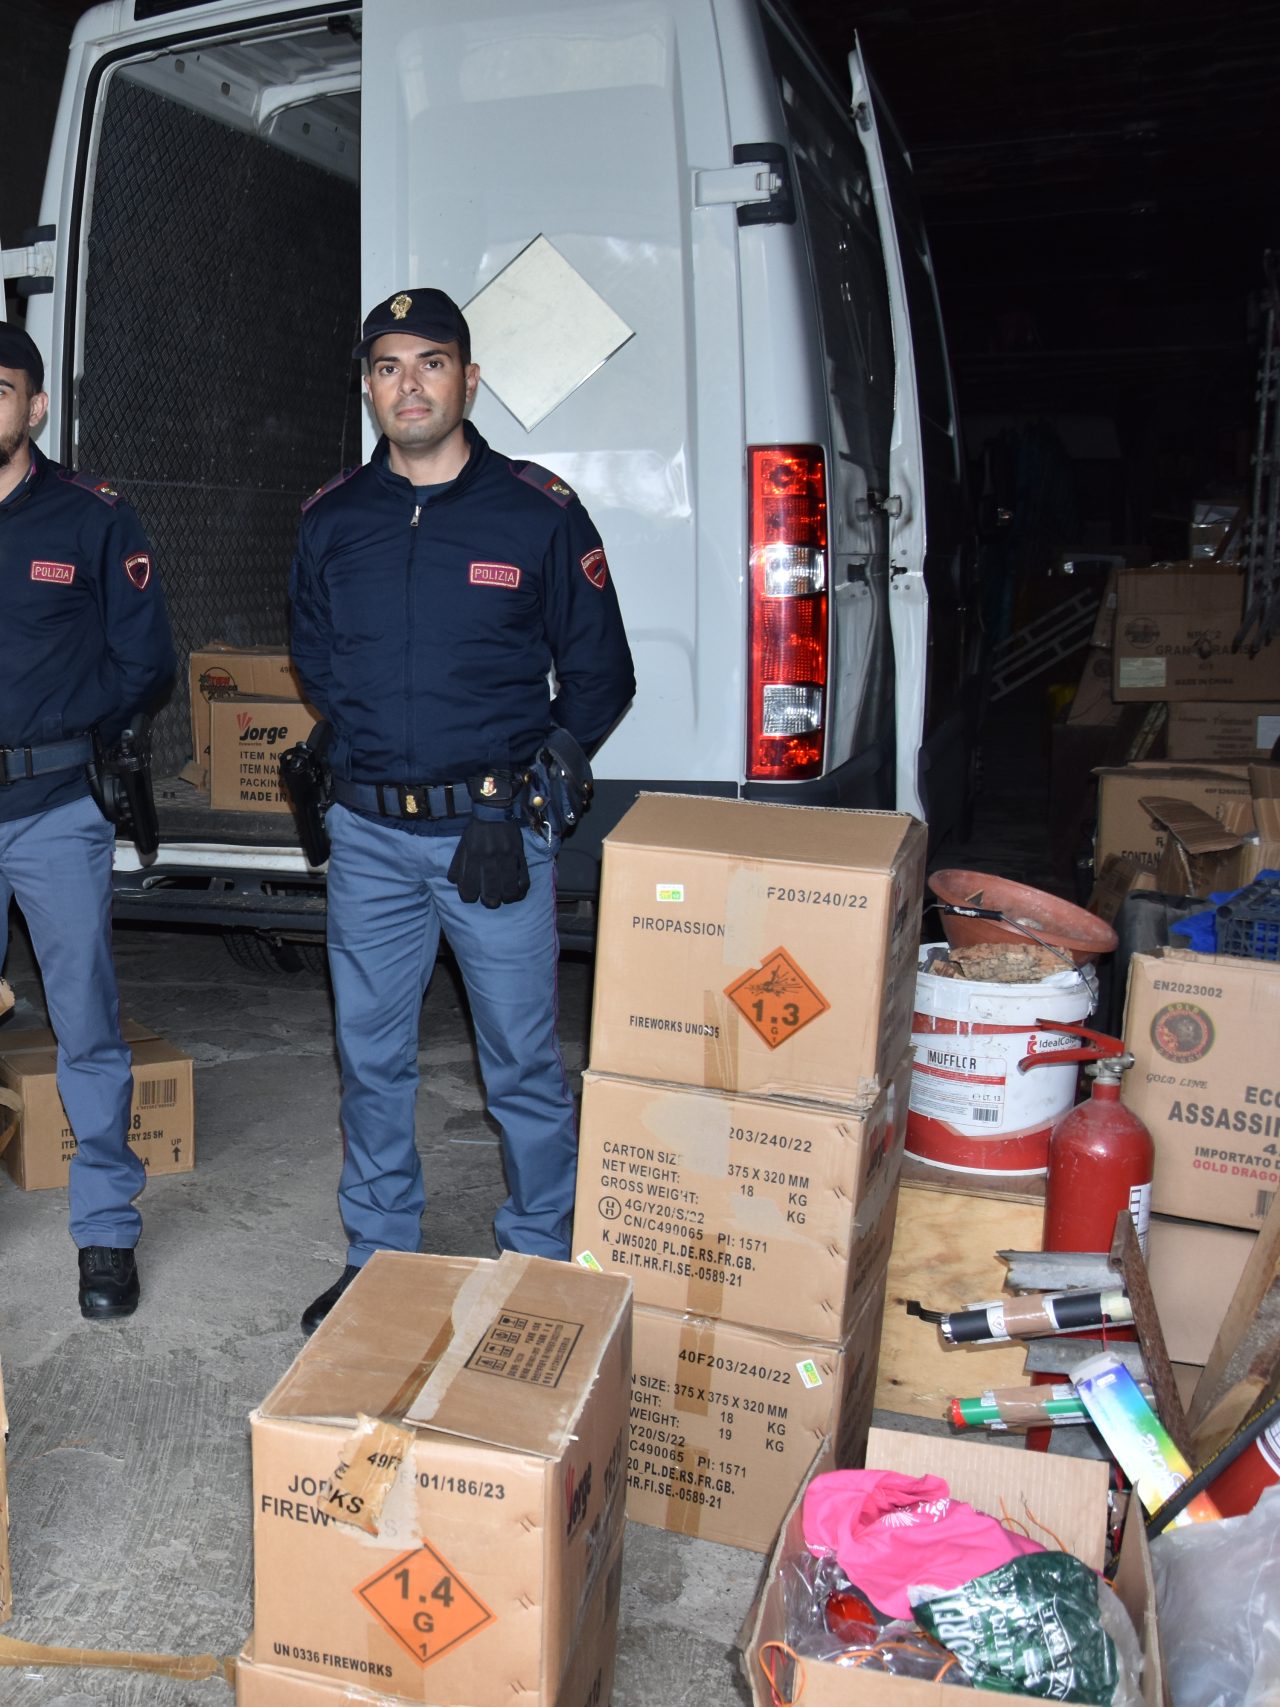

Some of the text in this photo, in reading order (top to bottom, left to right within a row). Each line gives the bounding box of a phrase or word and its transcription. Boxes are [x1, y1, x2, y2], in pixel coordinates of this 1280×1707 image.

[35, 566, 69, 579] POLIZIA
[475, 569, 514, 583] POLIZIA
[240, 726, 288, 744] Jorge
[240, 752, 264, 760] ITEM
[240, 791, 287, 802] MADE IN
[1153, 980, 1222, 998] EN2023002
[629, 1015, 682, 1032] FIREWORKS
[751, 999, 800, 1026] 1.3
[143, 1131, 163, 1140] 25 SH
[604, 1142, 654, 1161] CARTON
[1195, 1147, 1271, 1167] IMPORTATO
[602, 1158, 808, 1207] NET WEIGHT: 18 KG
[728, 1164, 809, 1188] 375 X 320 MM
[1193, 1160, 1280, 1183] GOLD DRAGO
[601, 1176, 643, 1193] GROSS
[787, 1211, 806, 1224] KG
[624, 1214, 767, 1252] CN/C490065 PI: 1571
[679, 1349, 791, 1384] 40F203/240/22
[640, 1376, 788, 1419] SIZE: 375 375 320 MM
[720, 1411, 786, 1435] 18 KG
[719, 1428, 784, 1452] 19 KG
[262, 1495, 336, 1526] FIREW
[394, 1568, 454, 1607] 1.4
[413, 1611, 434, 1633] G
[274, 1642, 392, 1677] UN 0336 FIREWORKS
[419, 1643, 427, 1656] 1
